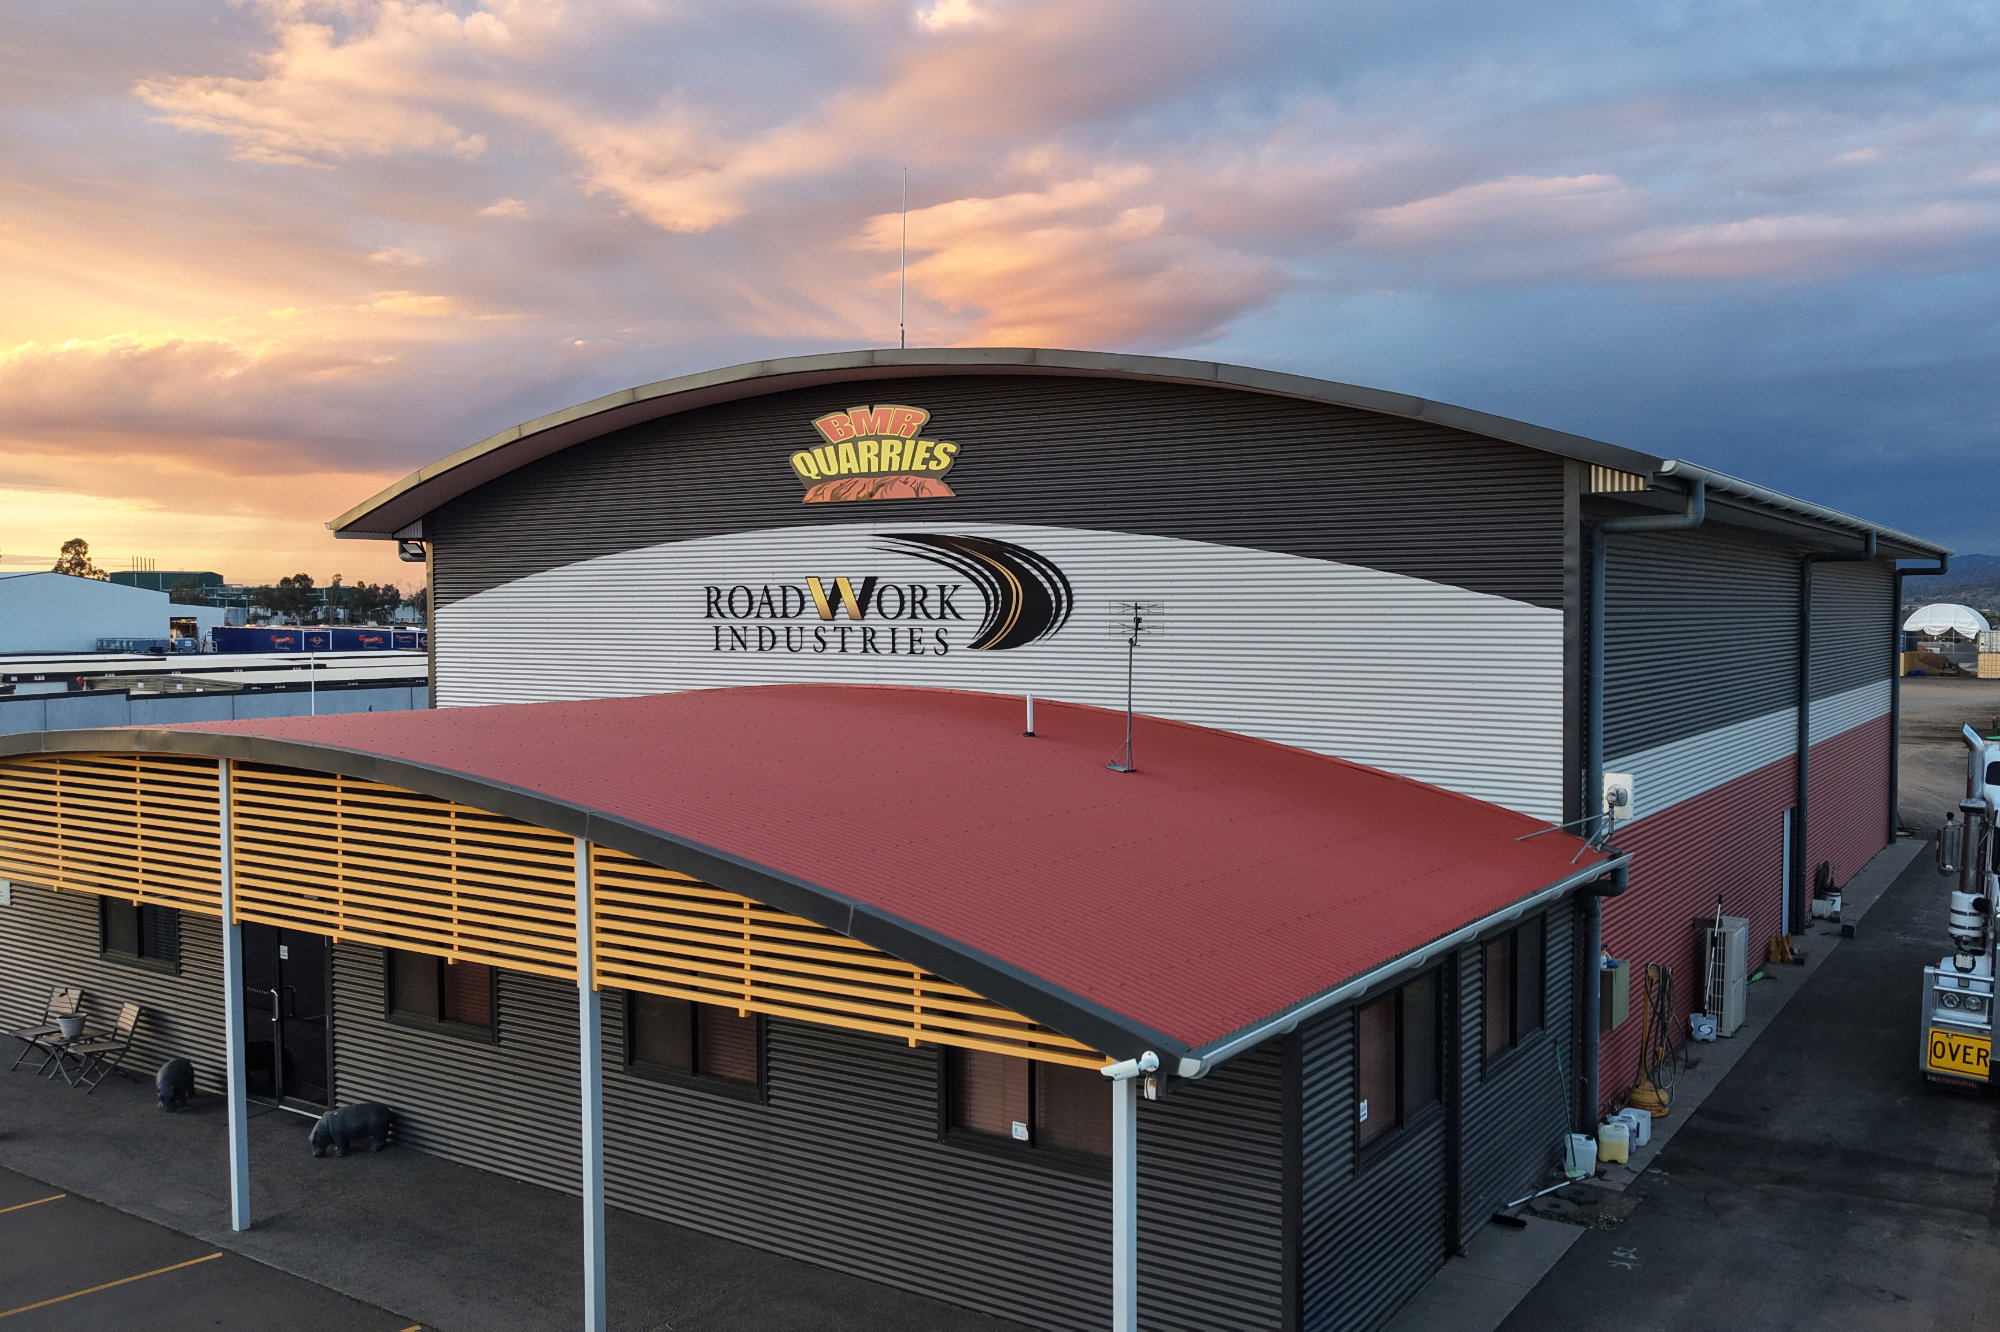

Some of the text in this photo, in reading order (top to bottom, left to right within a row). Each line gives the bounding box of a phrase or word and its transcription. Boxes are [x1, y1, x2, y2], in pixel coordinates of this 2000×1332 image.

[814, 407, 927, 443] BMR
[791, 440, 958, 480] QUARRIES
[704, 576, 965, 622] ROADWORK
[713, 625, 951, 657] INDUSTRIES
[1933, 1040, 1990, 1068] OVER
